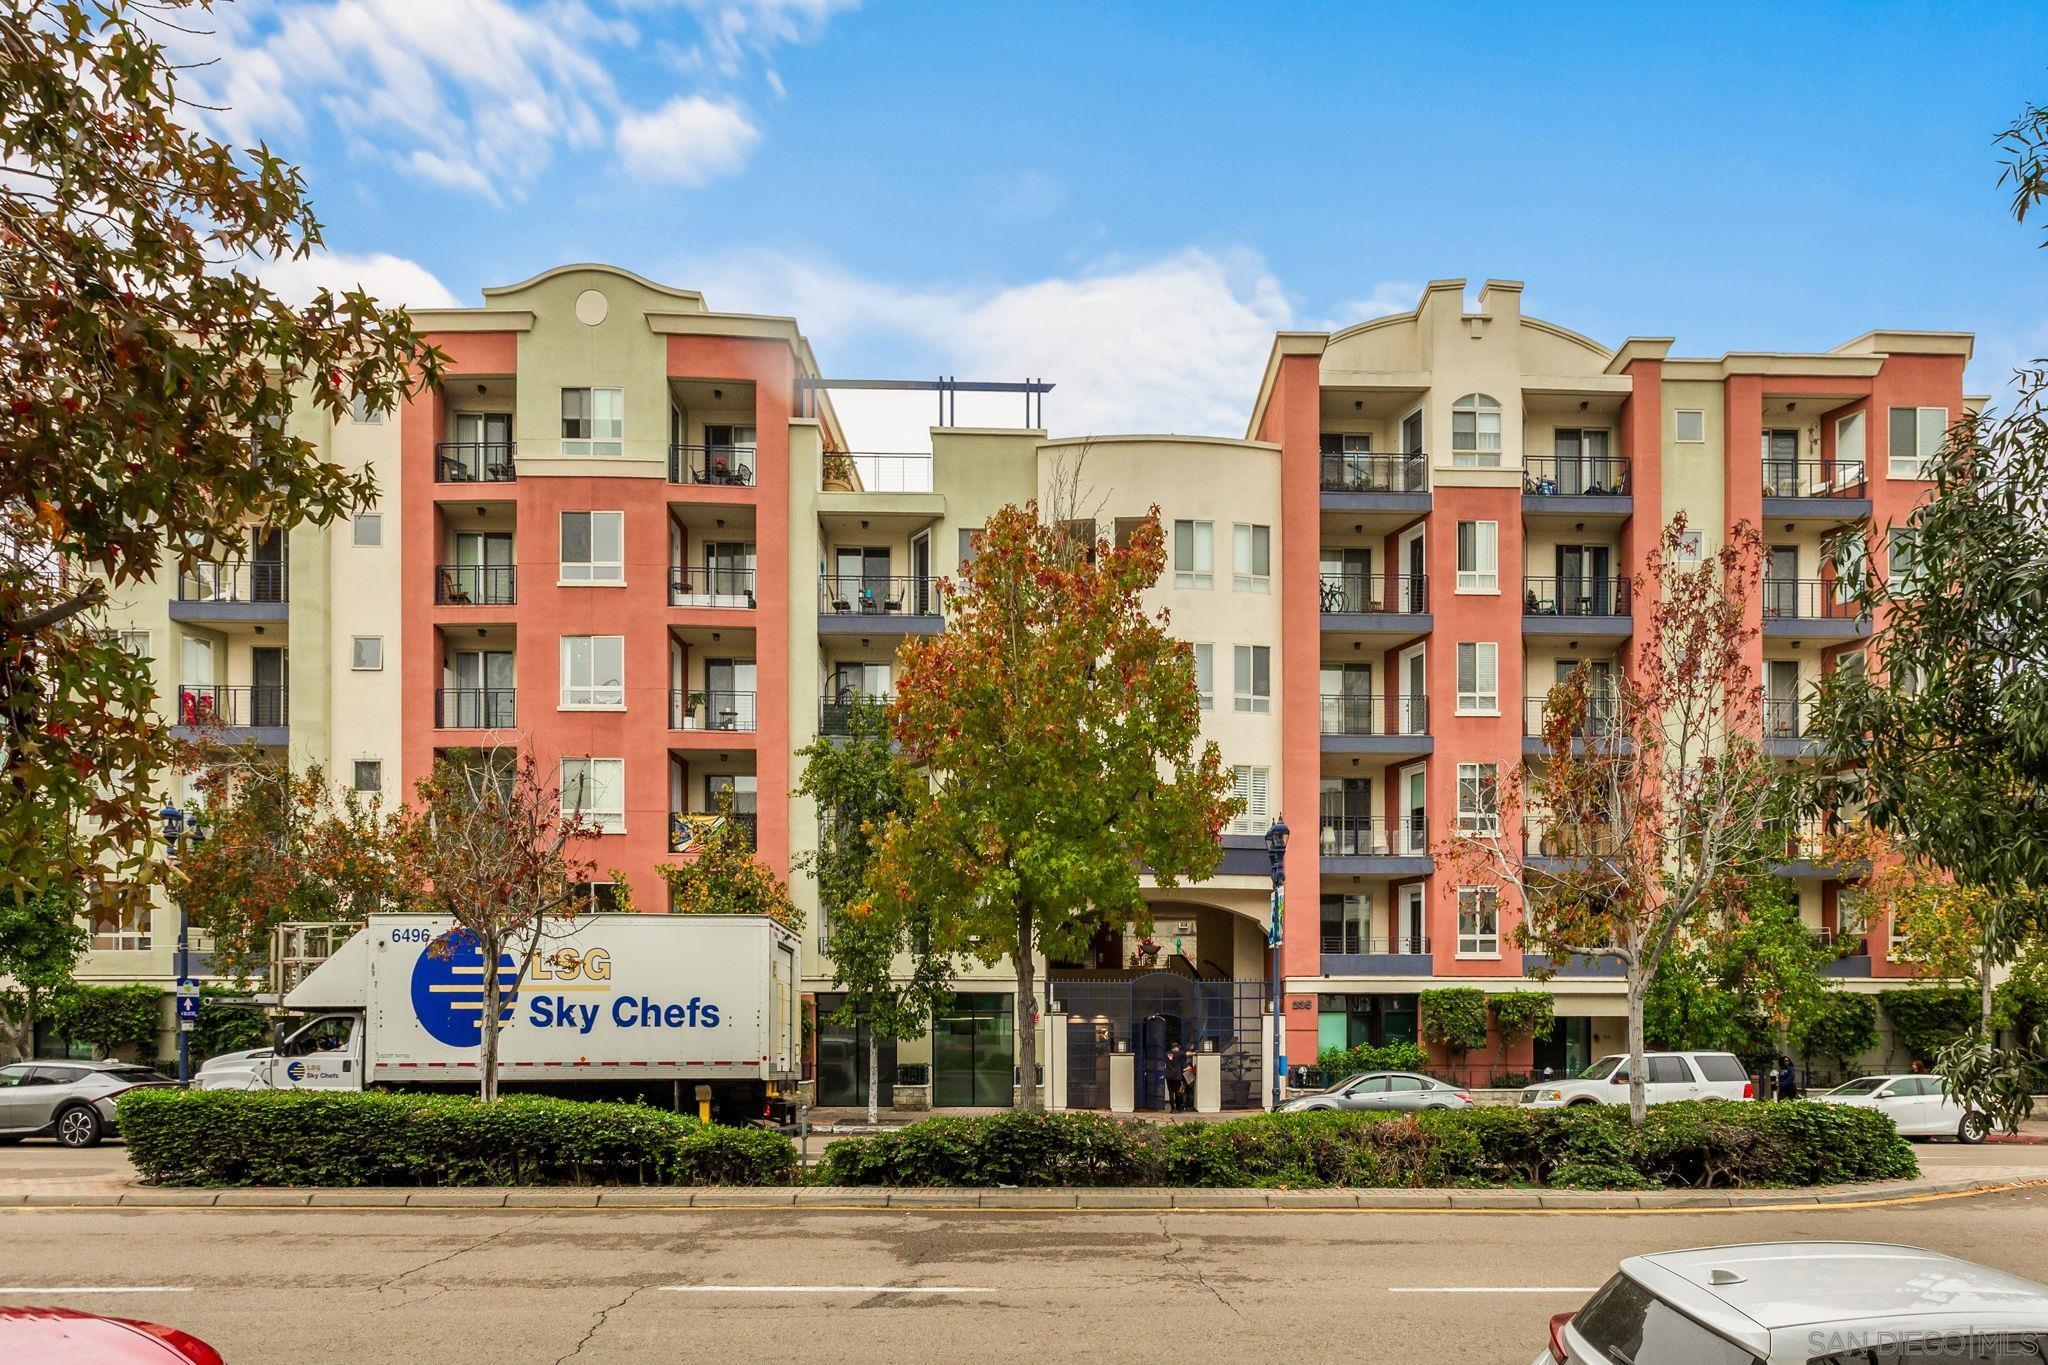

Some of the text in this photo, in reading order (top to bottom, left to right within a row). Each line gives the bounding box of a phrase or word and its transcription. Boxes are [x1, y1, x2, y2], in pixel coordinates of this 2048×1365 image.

[392, 928, 430, 943] 6496
[531, 947, 611, 981] LSG
[529, 995, 720, 1034] Sky Chefs
[306, 1072, 319, 1080] Sky
